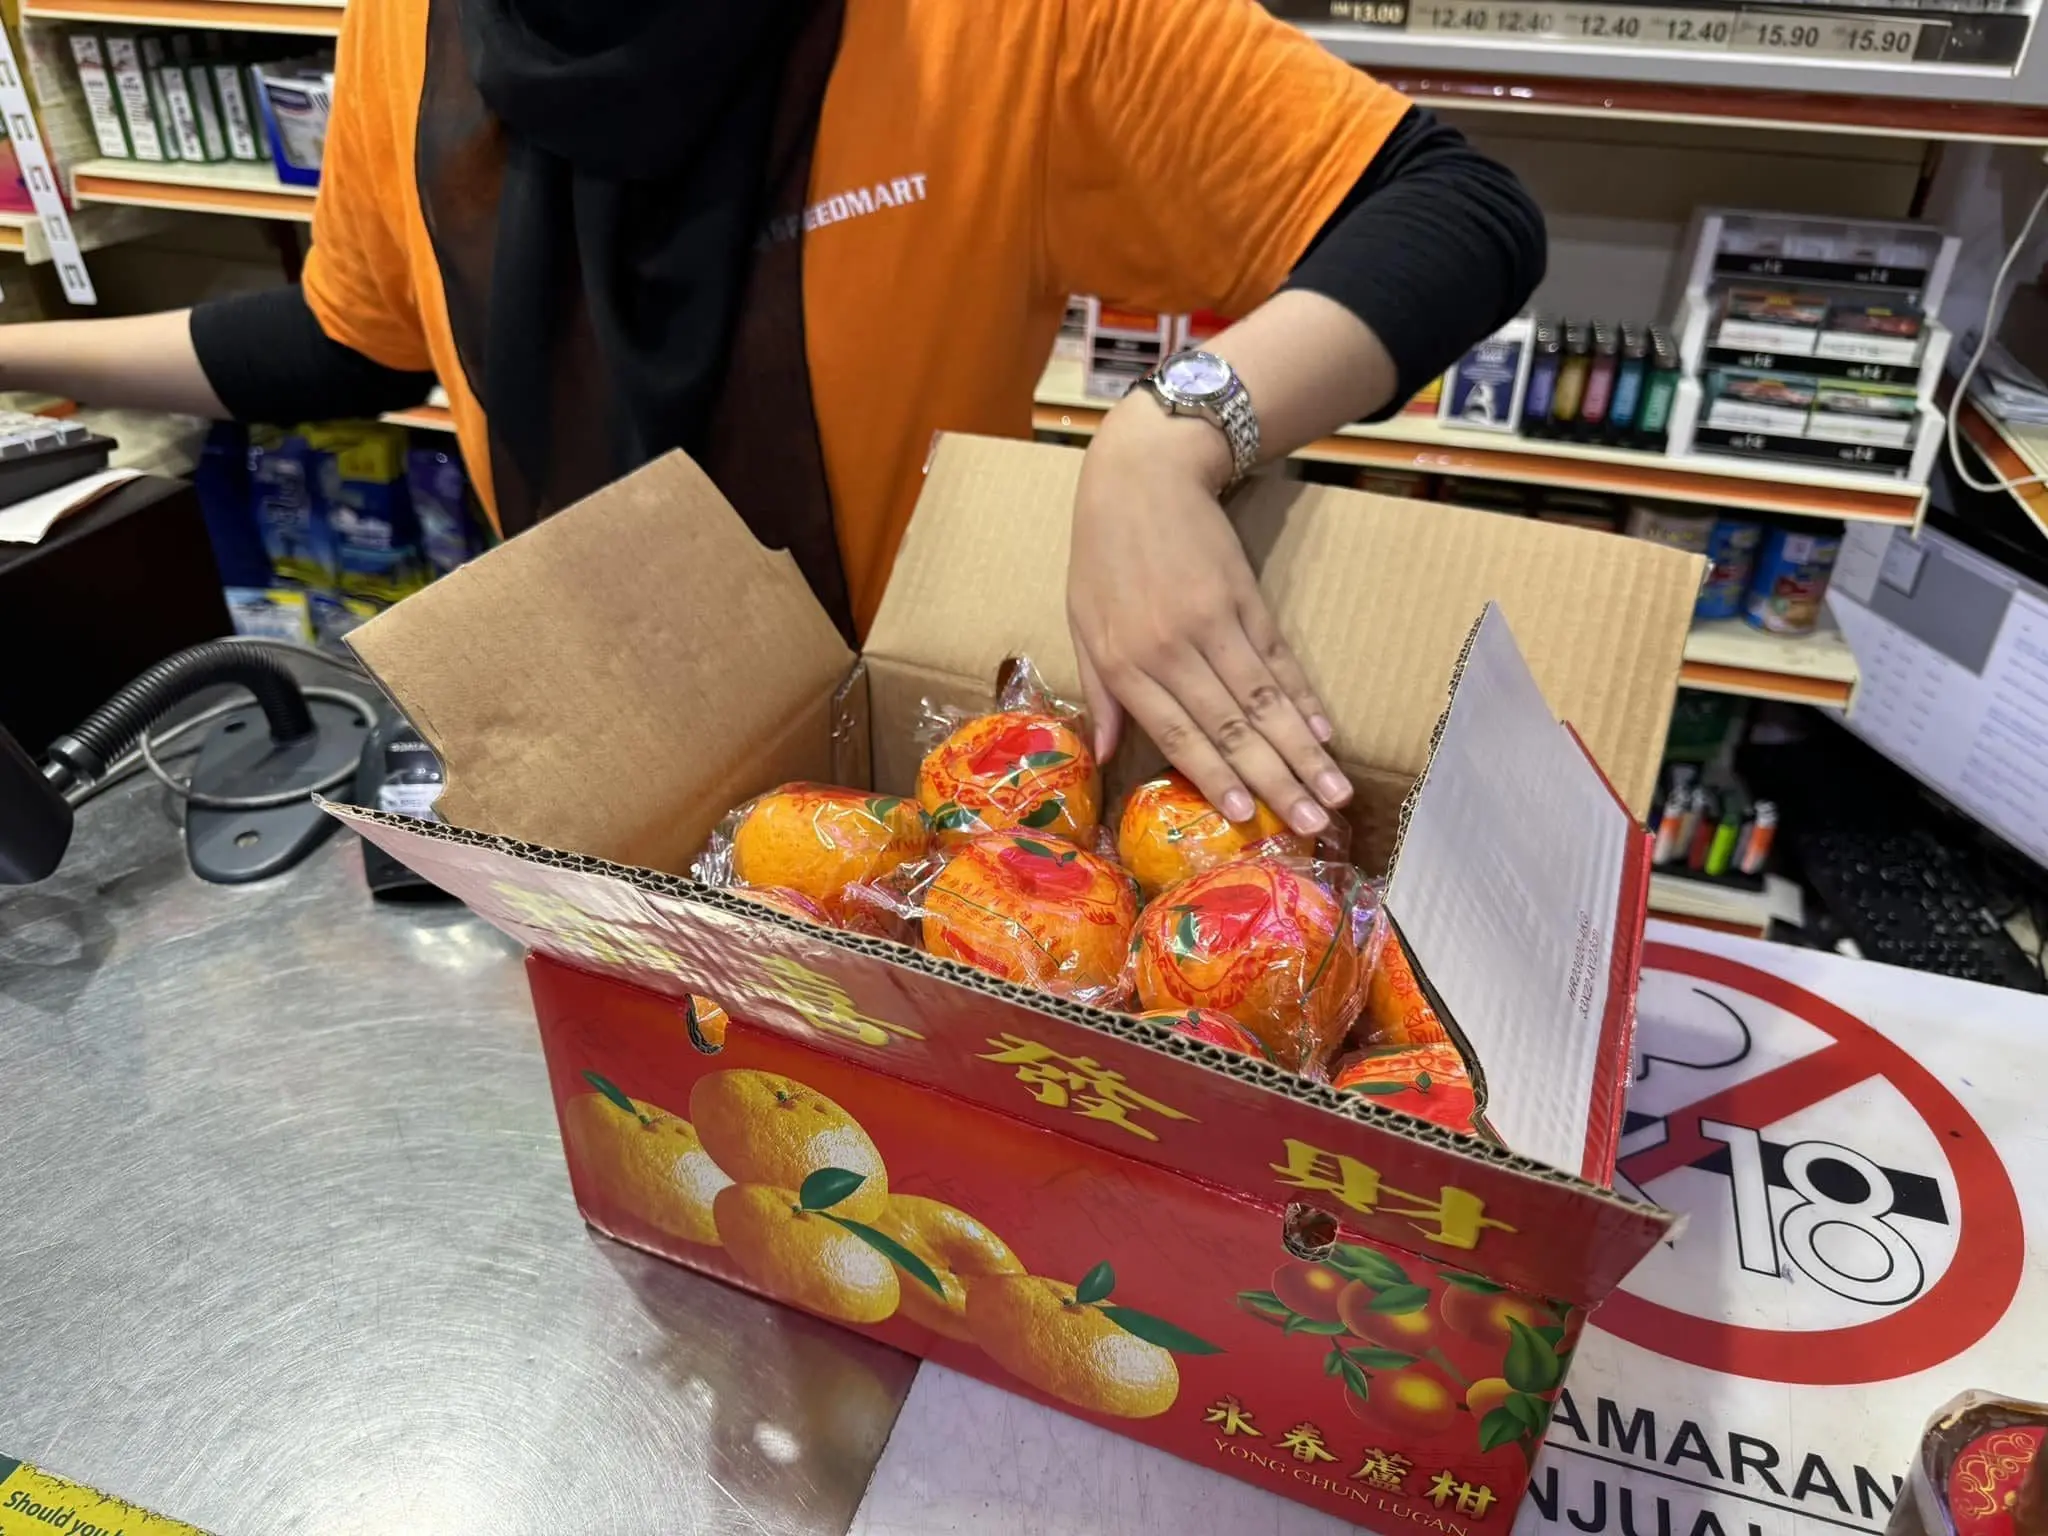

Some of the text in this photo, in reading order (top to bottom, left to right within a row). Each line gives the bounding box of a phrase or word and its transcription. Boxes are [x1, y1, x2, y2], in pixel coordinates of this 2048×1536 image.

[1431, 7, 1486, 31] 12.40
[1580, 13, 1641, 37] 12.40
[1666, 20, 1727, 43] 12.40
[1757, 25, 1819, 48] 15.90
[1847, 29, 1911, 53] 15.90
[1699, 1116, 1925, 1306] 18
[1213, 1437, 1469, 1536] YONG CHUN LUGAN
[2, 1490, 76, 1529] Should
[1527, 1466, 1763, 1536] NJU
